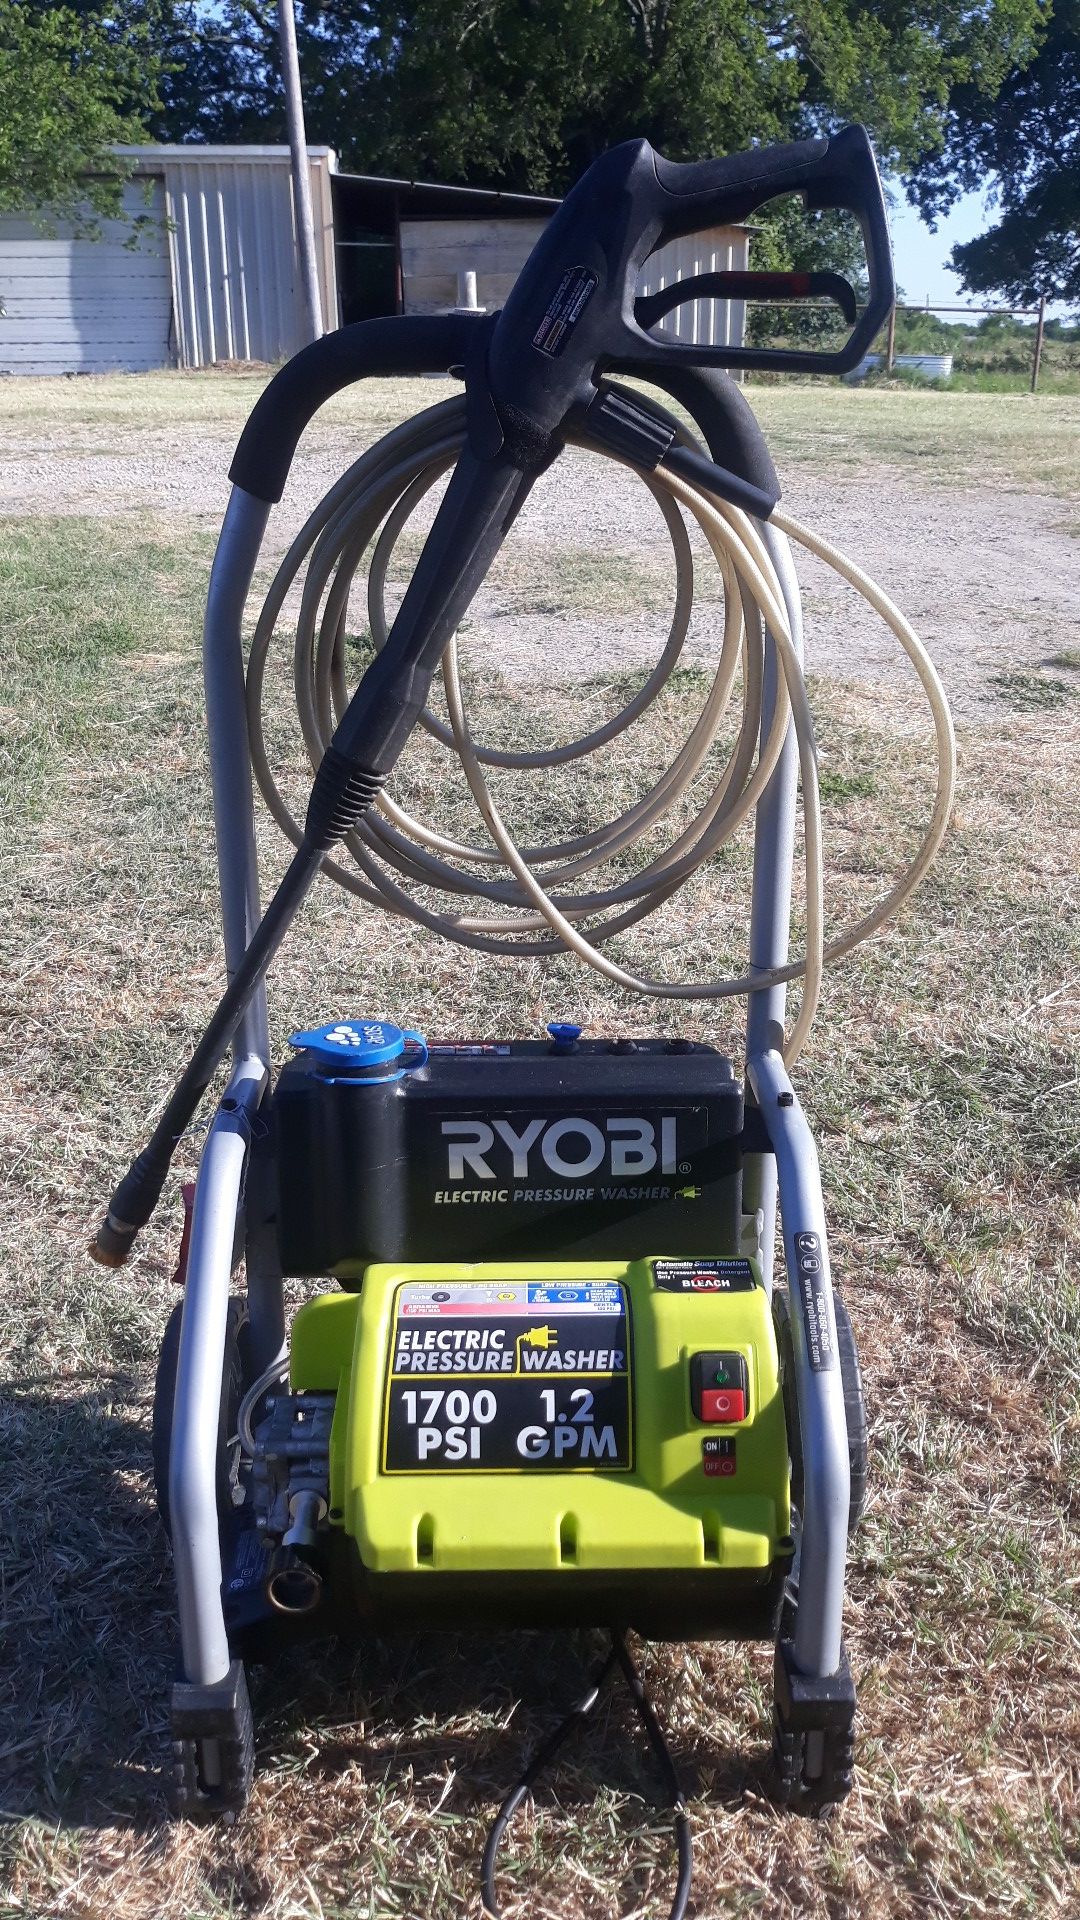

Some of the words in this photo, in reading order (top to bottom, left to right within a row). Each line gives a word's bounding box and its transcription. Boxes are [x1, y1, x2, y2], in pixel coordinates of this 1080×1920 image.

[363, 1024, 386, 1045] SOAP
[441, 1117, 676, 1179] RYOBI
[434, 1190, 508, 1203] ELECTRIC
[513, 1188, 595, 1201] PRESSURE
[601, 1186, 671, 1200] WASHER
[682, 1279, 730, 1287] BLEACH
[804, 1278, 820, 1363] www.ryobitools.com
[398, 1329, 505, 1350] ELECTRIC
[395, 1351, 514, 1372] PRESSURE
[522, 1350, 624, 1370] WASHER
[401, 1389, 497, 1425] 1700
[539, 1388, 595, 1423] 1.2
[417, 1426, 482, 1460] PSI
[516, 1425, 618, 1459] GPM
[706, 1441, 717, 1451] ON
[705, 1462, 719, 1470] OFF
